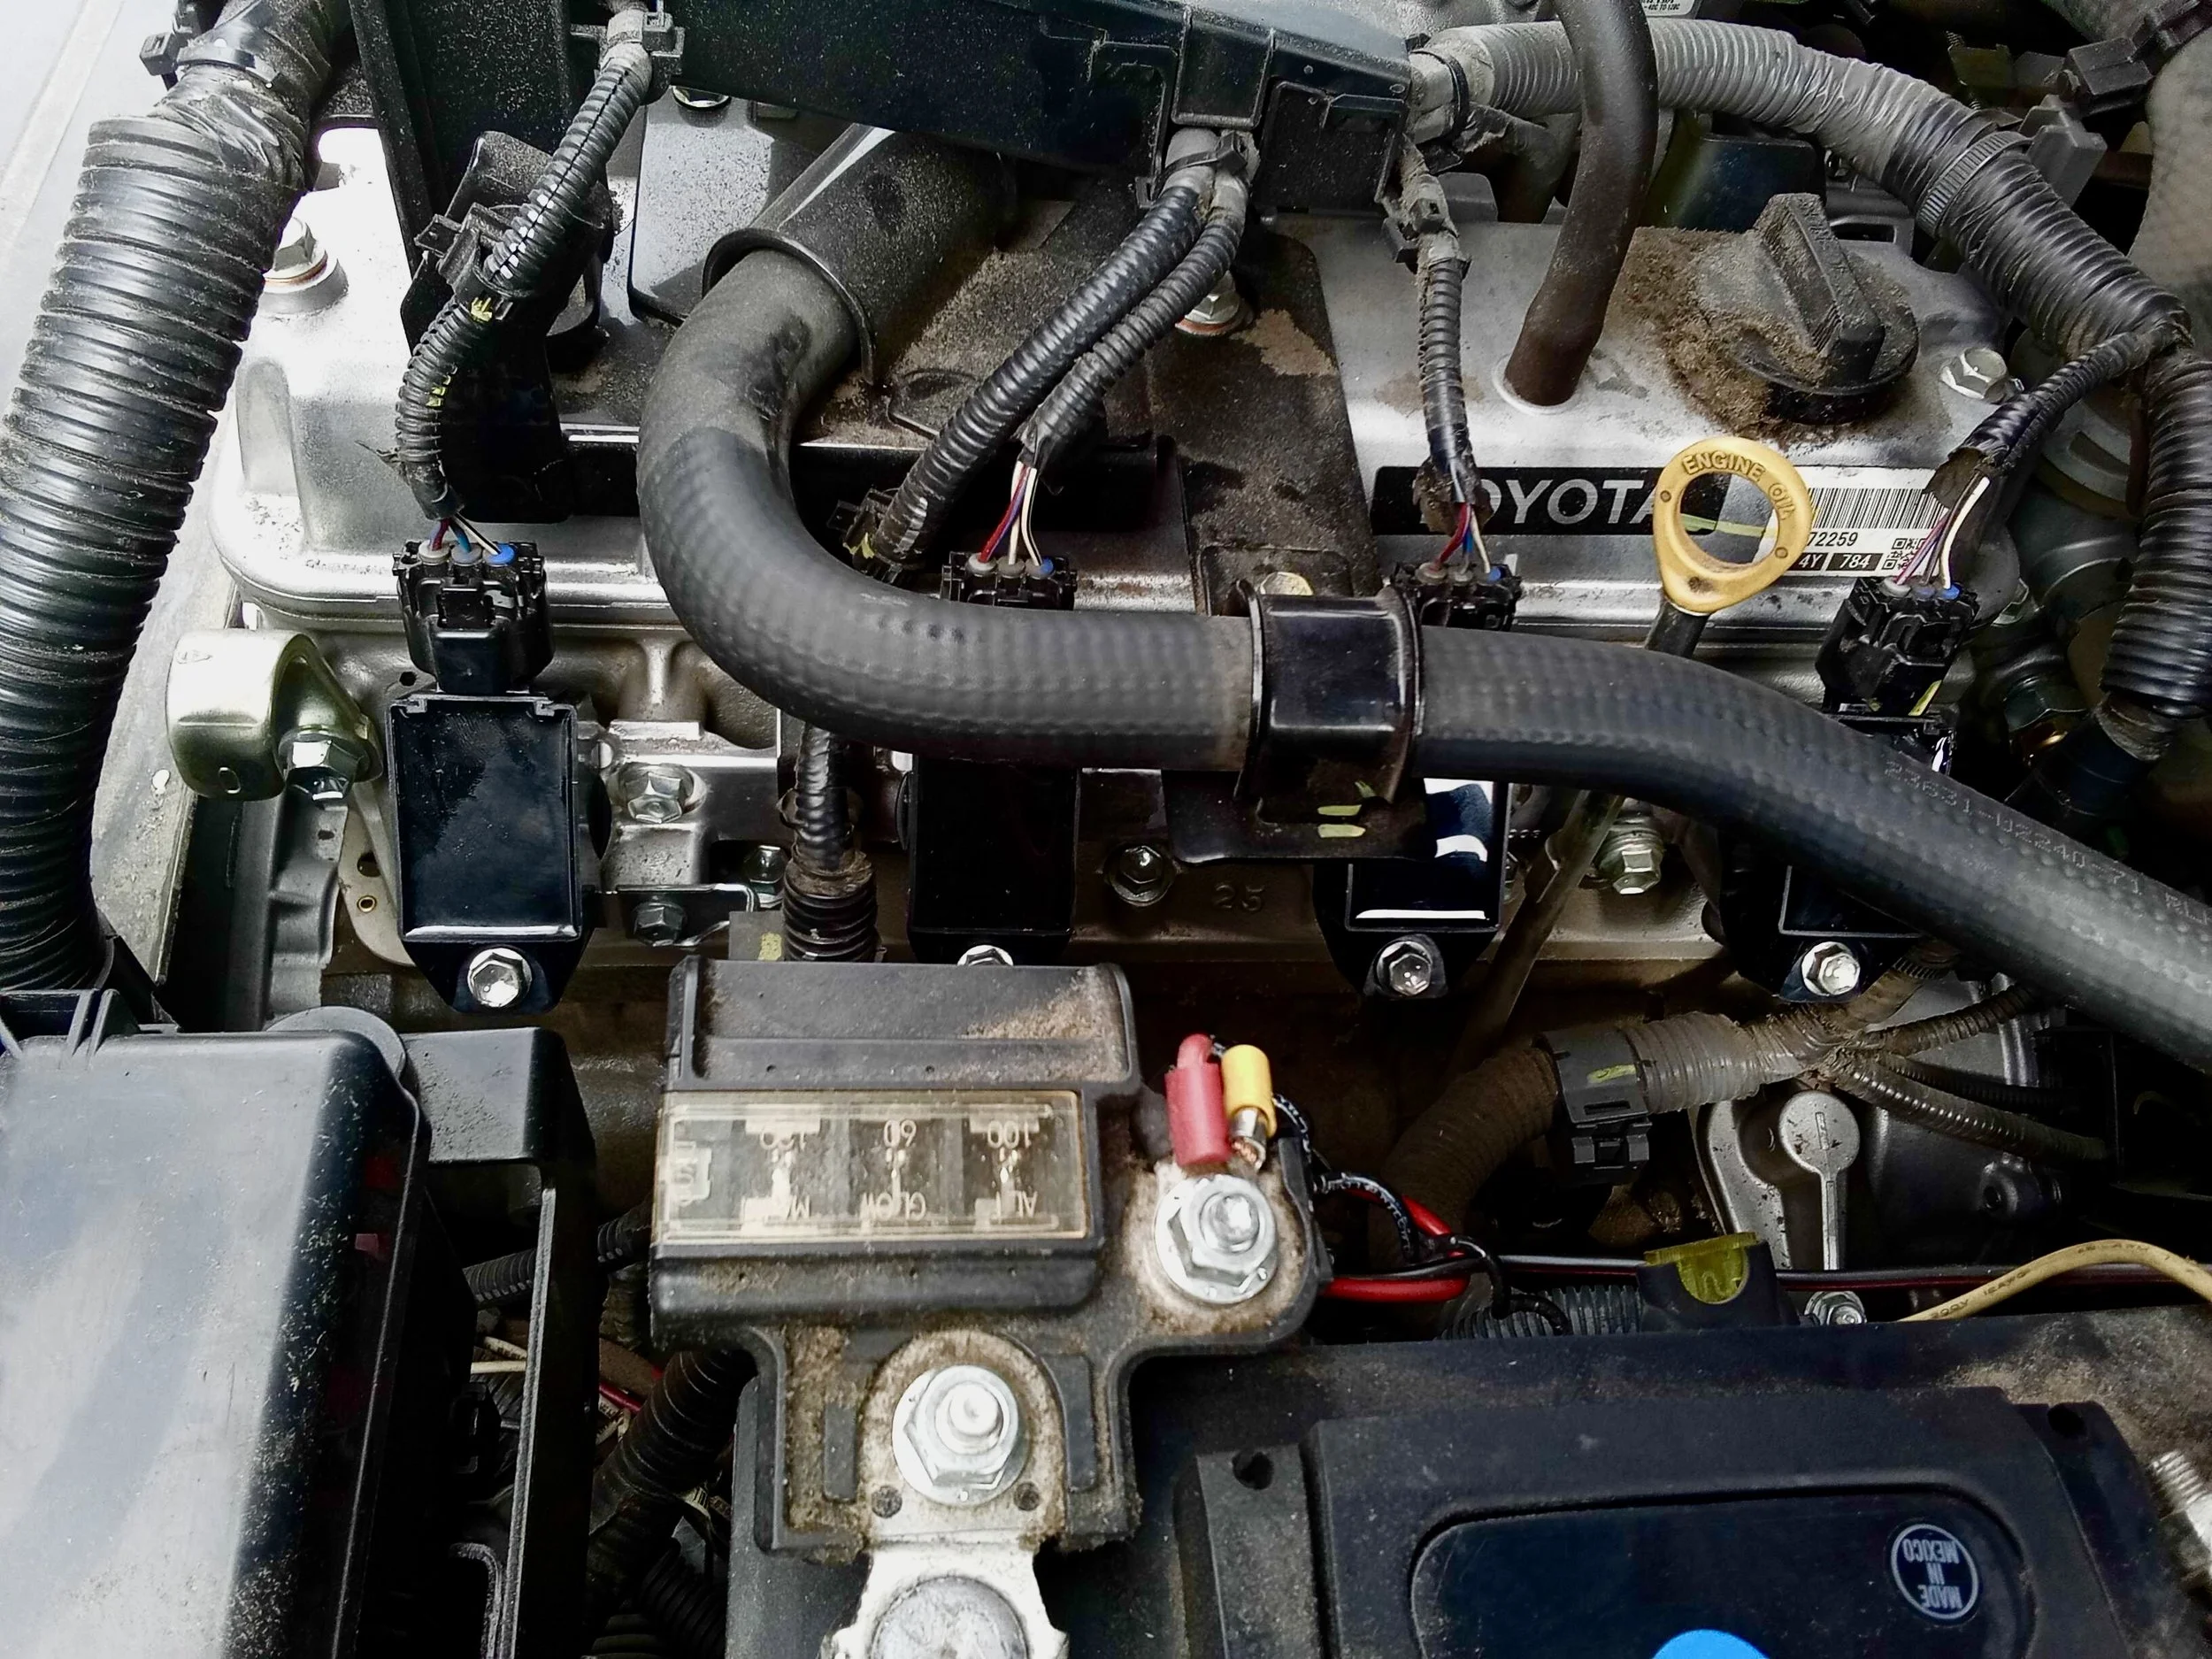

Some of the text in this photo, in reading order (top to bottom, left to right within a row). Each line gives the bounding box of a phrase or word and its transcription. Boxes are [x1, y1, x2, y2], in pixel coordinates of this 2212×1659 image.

[1681, 450, 1796, 520] ENGINE OIL
[1799, 554, 1870, 569] 4Y 784
[1214, 882, 1265, 912] 25
[884, 1118, 918, 1148] 60
[987, 1119, 1033, 1149] 100
[859, 1192, 927, 1224] GLOW
[1902, 1538, 1960, 1564] MEXICO
[1926, 1563, 1945, 1585] IN
[1917, 1584, 1963, 1609] MADE
